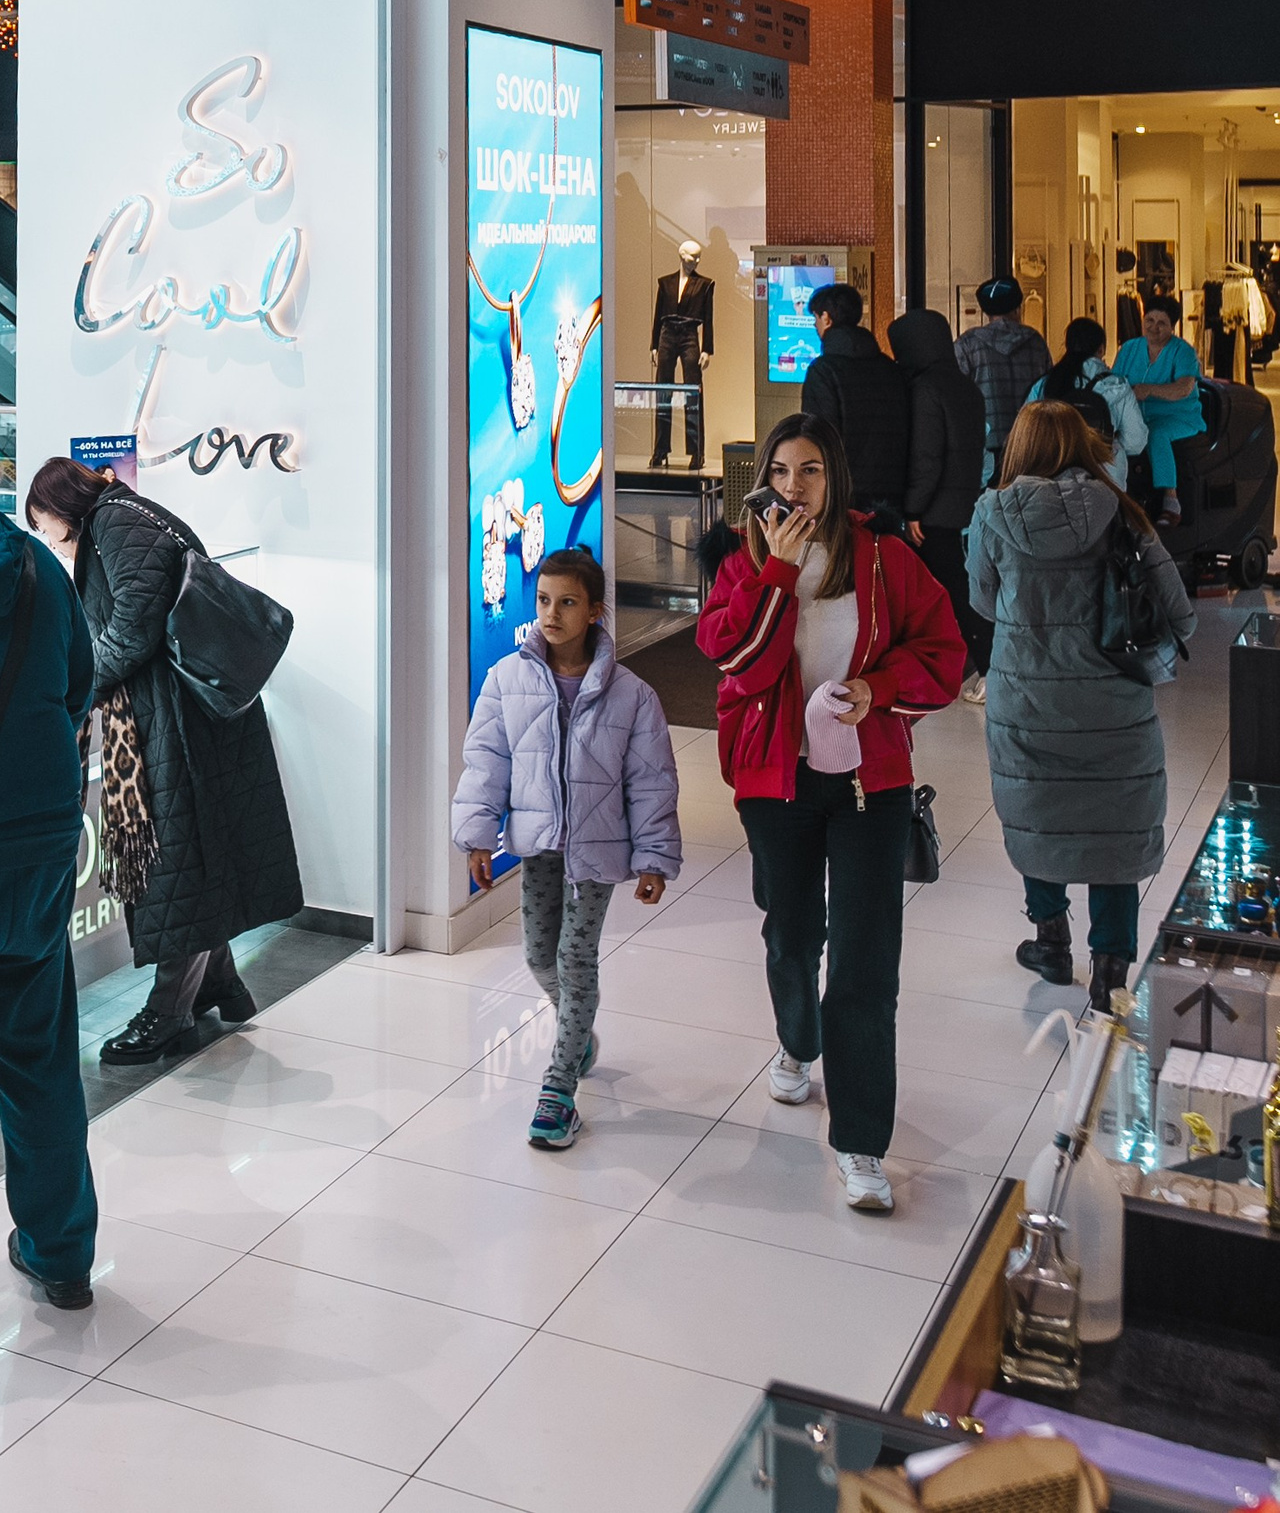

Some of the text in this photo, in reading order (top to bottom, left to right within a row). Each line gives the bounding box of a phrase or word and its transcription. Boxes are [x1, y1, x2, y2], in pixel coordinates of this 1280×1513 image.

[496, 72, 580, 119] SOKOLOV
[167, 55, 288, 197] So
[476, 147, 597, 199] ШОК-ЦЕНА
[477, 220, 597, 247] ИДЕАЛЬНЫЙ ПОДАРОК!
[74, 195, 302, 344] Cool
[132, 344, 302, 476] Love
[100, 441, 114, 449] НА
[116, 438, 132, 449] ВСЁ
